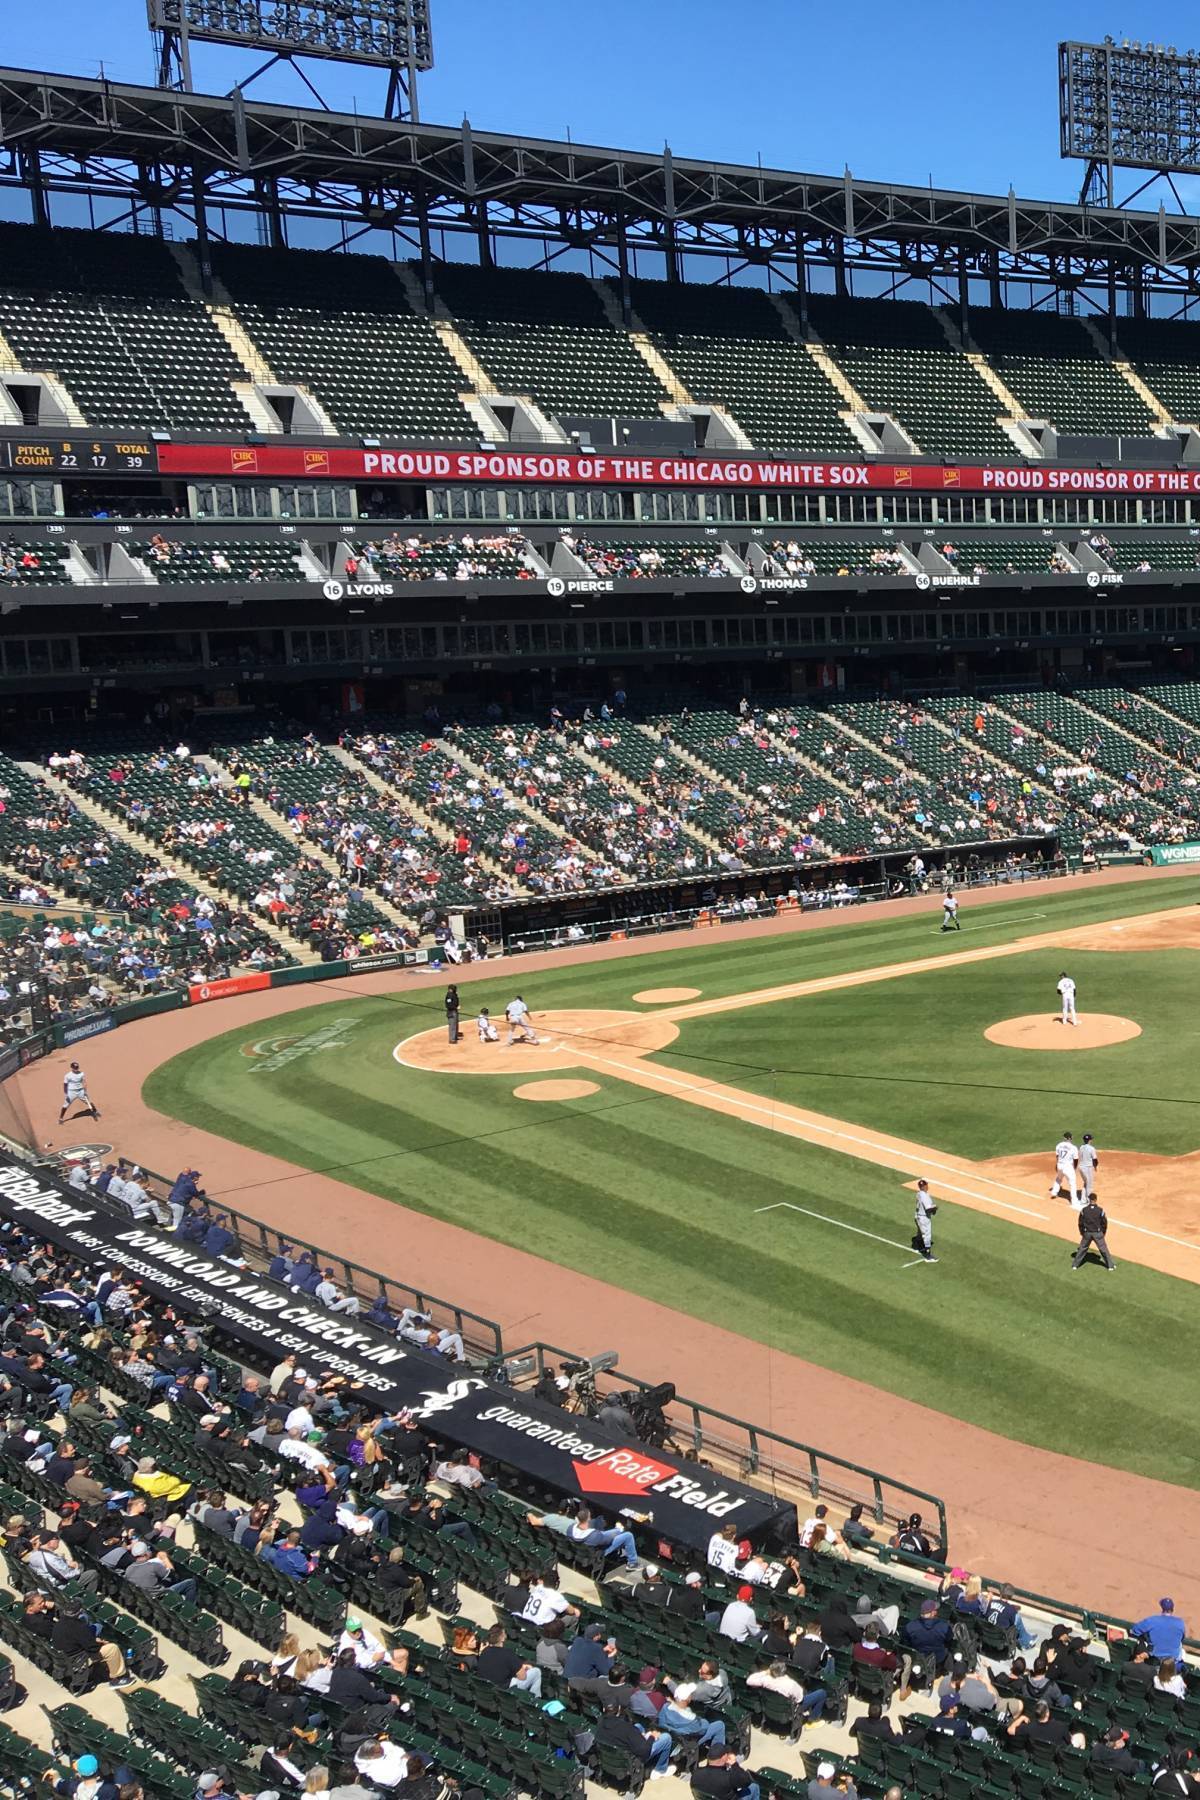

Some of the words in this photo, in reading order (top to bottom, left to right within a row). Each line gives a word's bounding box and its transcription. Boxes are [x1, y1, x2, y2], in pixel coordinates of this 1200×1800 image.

[17, 446, 50, 456] PITCH
[63, 443, 72, 452] B
[93, 444, 100, 453] S
[115, 444, 150, 455] TOTAL
[15, 456, 54, 466] COUNT
[61, 455, 77, 466] 22
[92, 455, 107, 467] 17
[127, 456, 143, 468] 39
[233, 452, 255, 461] CIBC
[363, 453, 450, 475] PROUD
[457, 456, 570, 478] SPONSOR
[577, 459, 606, 478] OF
[611, 460, 653, 480] THE
[659, 461, 753, 482] CHICAGO
[758, 465, 824, 484] WHITE
[829, 466, 869, 485] SOX
[983, 470, 1044, 487] PROUD
[1048, 471, 1129, 489] SPONSOR
[1133, 473, 1154, 488] OF
[1158, 474, 1189, 490] THE
[743, 580, 754, 589] 35
[759, 579, 808, 589] THOMAS
[917, 577, 929, 586] 56
[932, 576, 980, 586] BUEHRLE
[1088, 575, 1099, 584] 72
[1102, 574, 1124, 583] FISK
[326, 584, 339, 595] 16
[347, 584, 394, 596] LYONS
[551, 582, 562, 592] 19
[568, 581, 614, 592] PIERCE
[1161, 847, 1190, 859] WGN
[352, 958, 397, 969] whitesox.com
[63, 1019, 111, 1041] PROGRESSIVE
[0, 1178, 97, 1227] Ballpark
[115, 1230, 242, 1287] DOWNLOAD
[225, 1285, 288, 1310] AND
[278, 1305, 407, 1365] CHECK-IN
[66, 1230, 103, 1249] MAPS
[101, 1247, 183, 1291] CONCESSIONS
[262, 1325, 279, 1337] &
[275, 1333, 314, 1354] SEAT
[311, 1351, 398, 1393] UPGRADES
[476, 1405, 616, 1462] guaranteed
[600, 1448, 661, 1484] Rate
[651, 1475, 747, 1518] Field
[711, 1550, 724, 1566] 15
[761, 1567, 783, 1589] 24
[987, 1611, 999, 1626] 4
